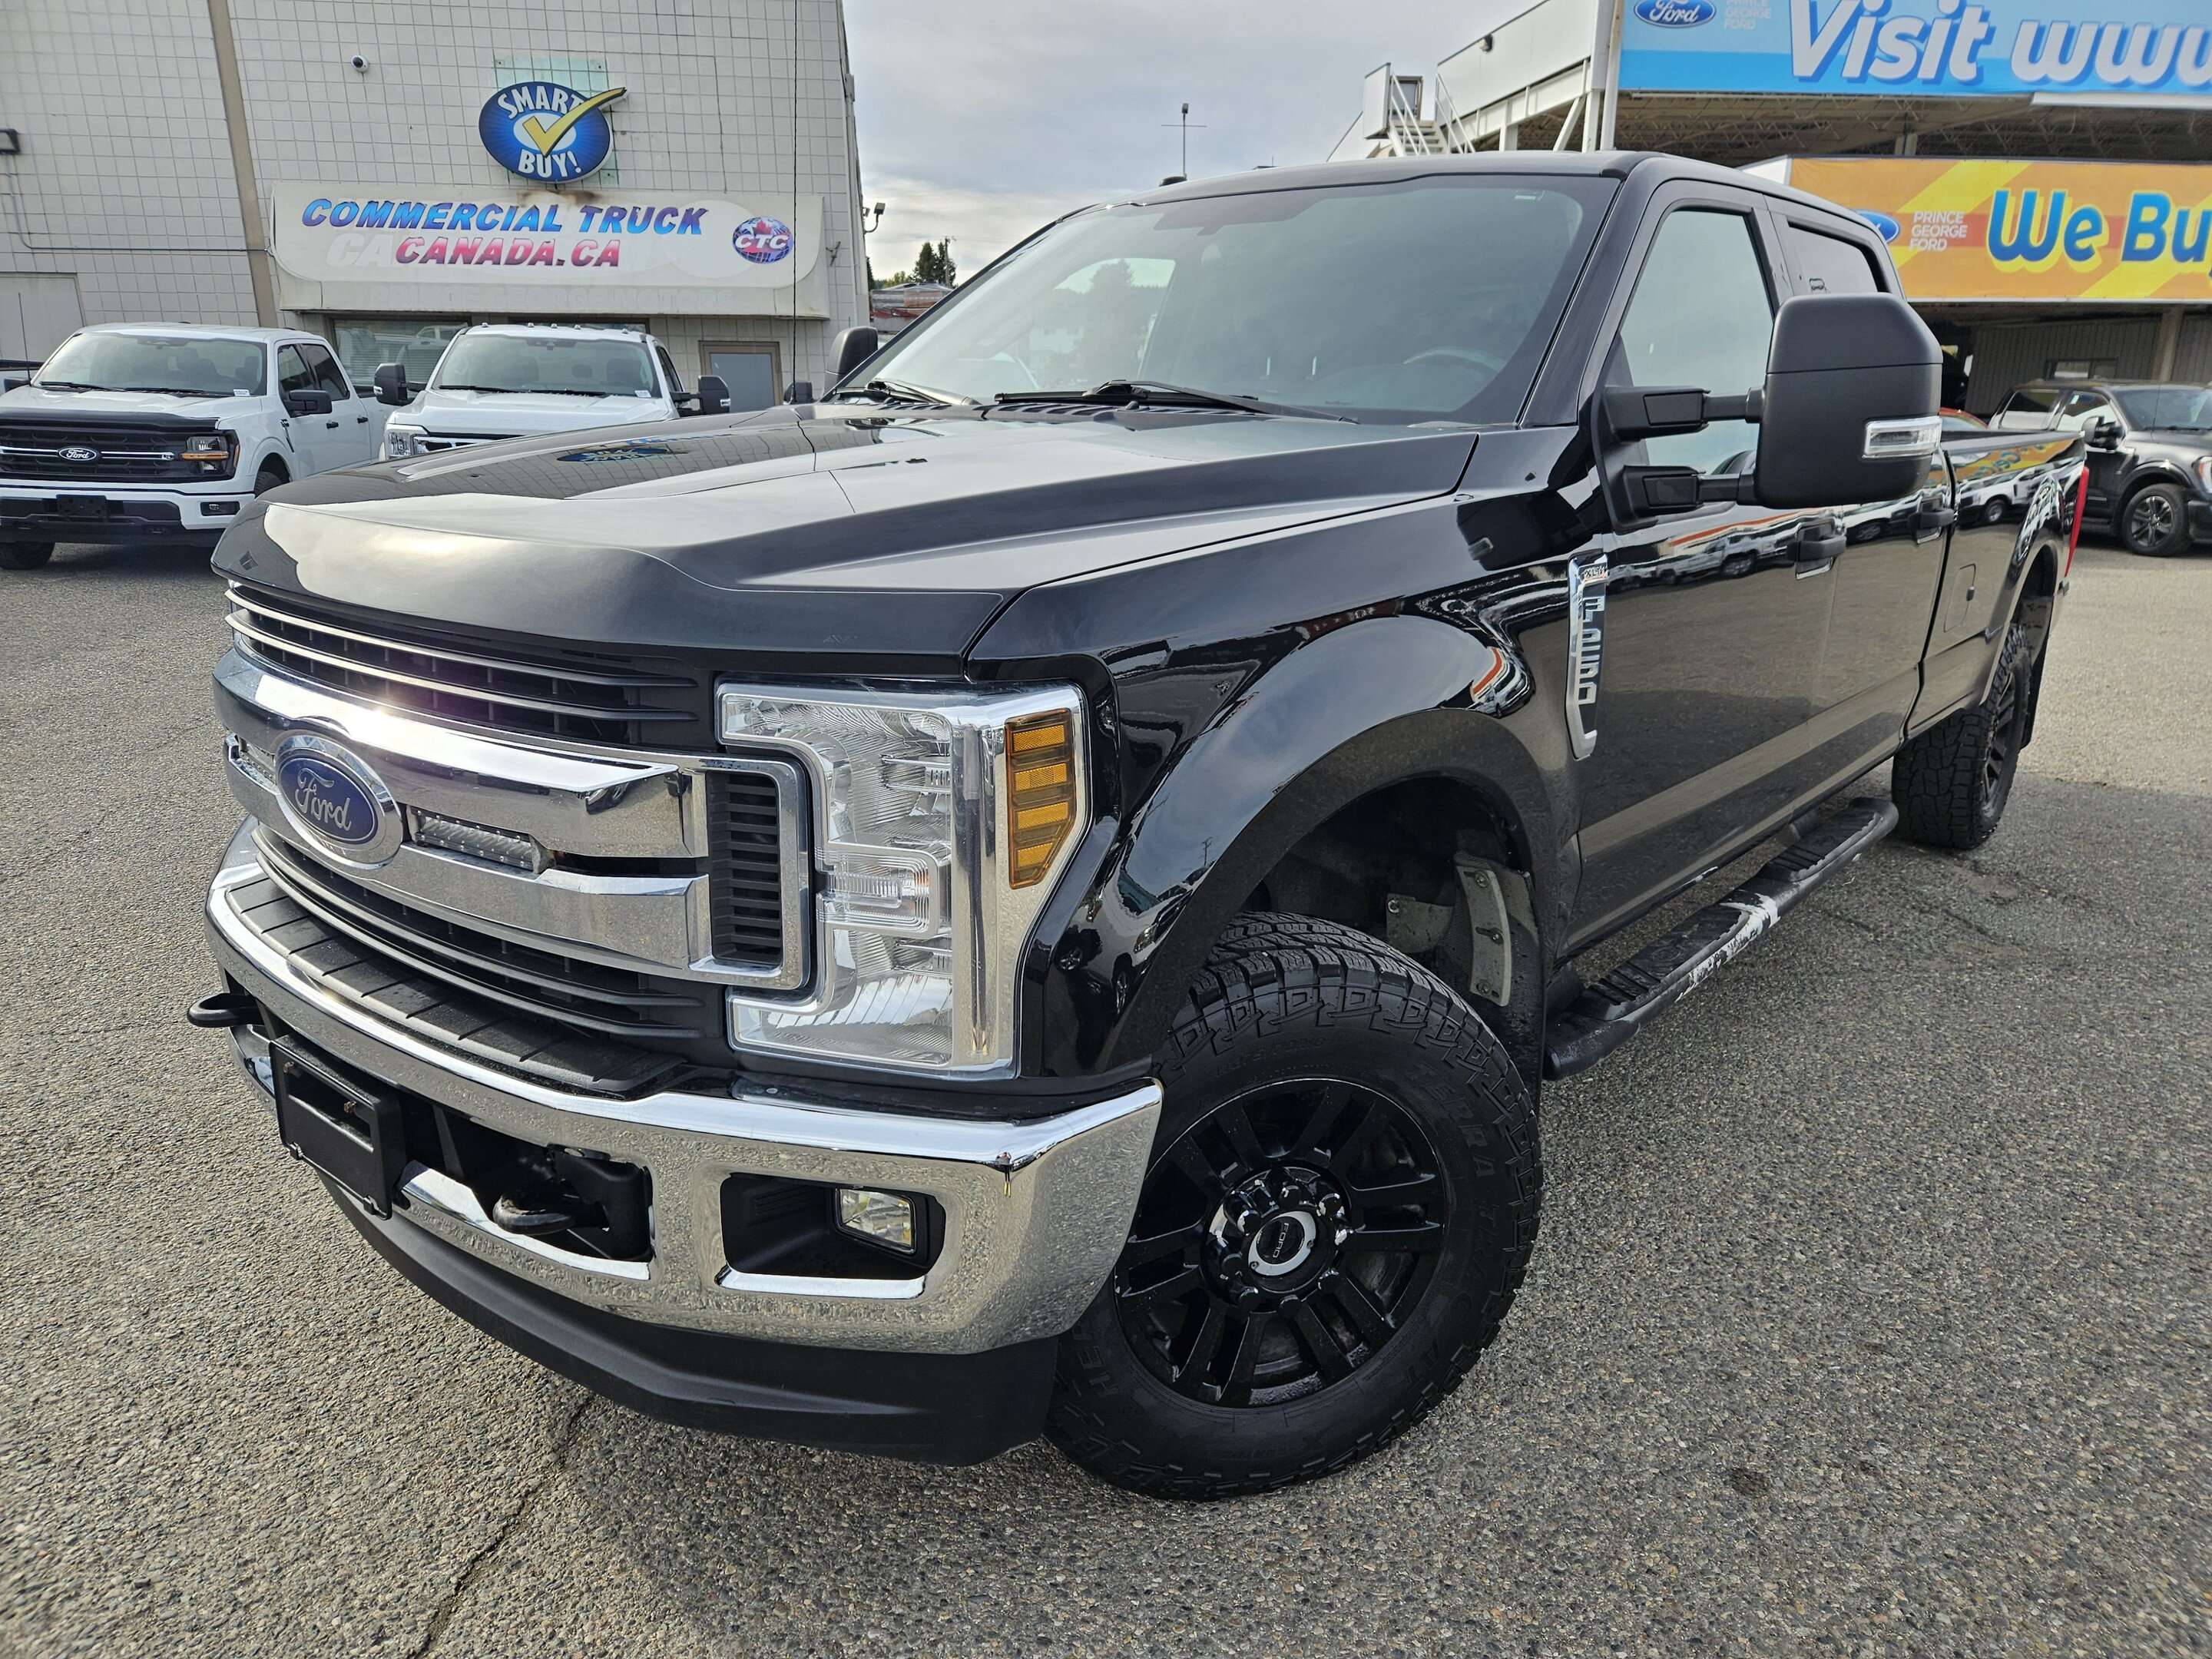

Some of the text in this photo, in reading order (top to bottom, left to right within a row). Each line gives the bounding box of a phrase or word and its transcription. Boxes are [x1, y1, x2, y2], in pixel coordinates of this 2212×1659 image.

[1648, 0, 1701, 23] Ford
[1789, 0, 1992, 81] Visit
[498, 85, 585, 120] SMART
[518, 148, 582, 178] BUY!
[301, 197, 708, 235] COMMERCIAL TRUCK
[1911, 224, 1969, 238] GEORGE
[1913, 211, 1965, 225] PRINCE
[735, 232, 790, 250] CTC
[1909, 238, 1949, 252] FORD
[1987, 189, 2212, 280] We Bu
[395, 236, 621, 267] CANADA.CA
[65, 449, 90, 459] Ford
[294, 767, 353, 832] Ford
[1272, 1222, 1290, 1259] FORD
